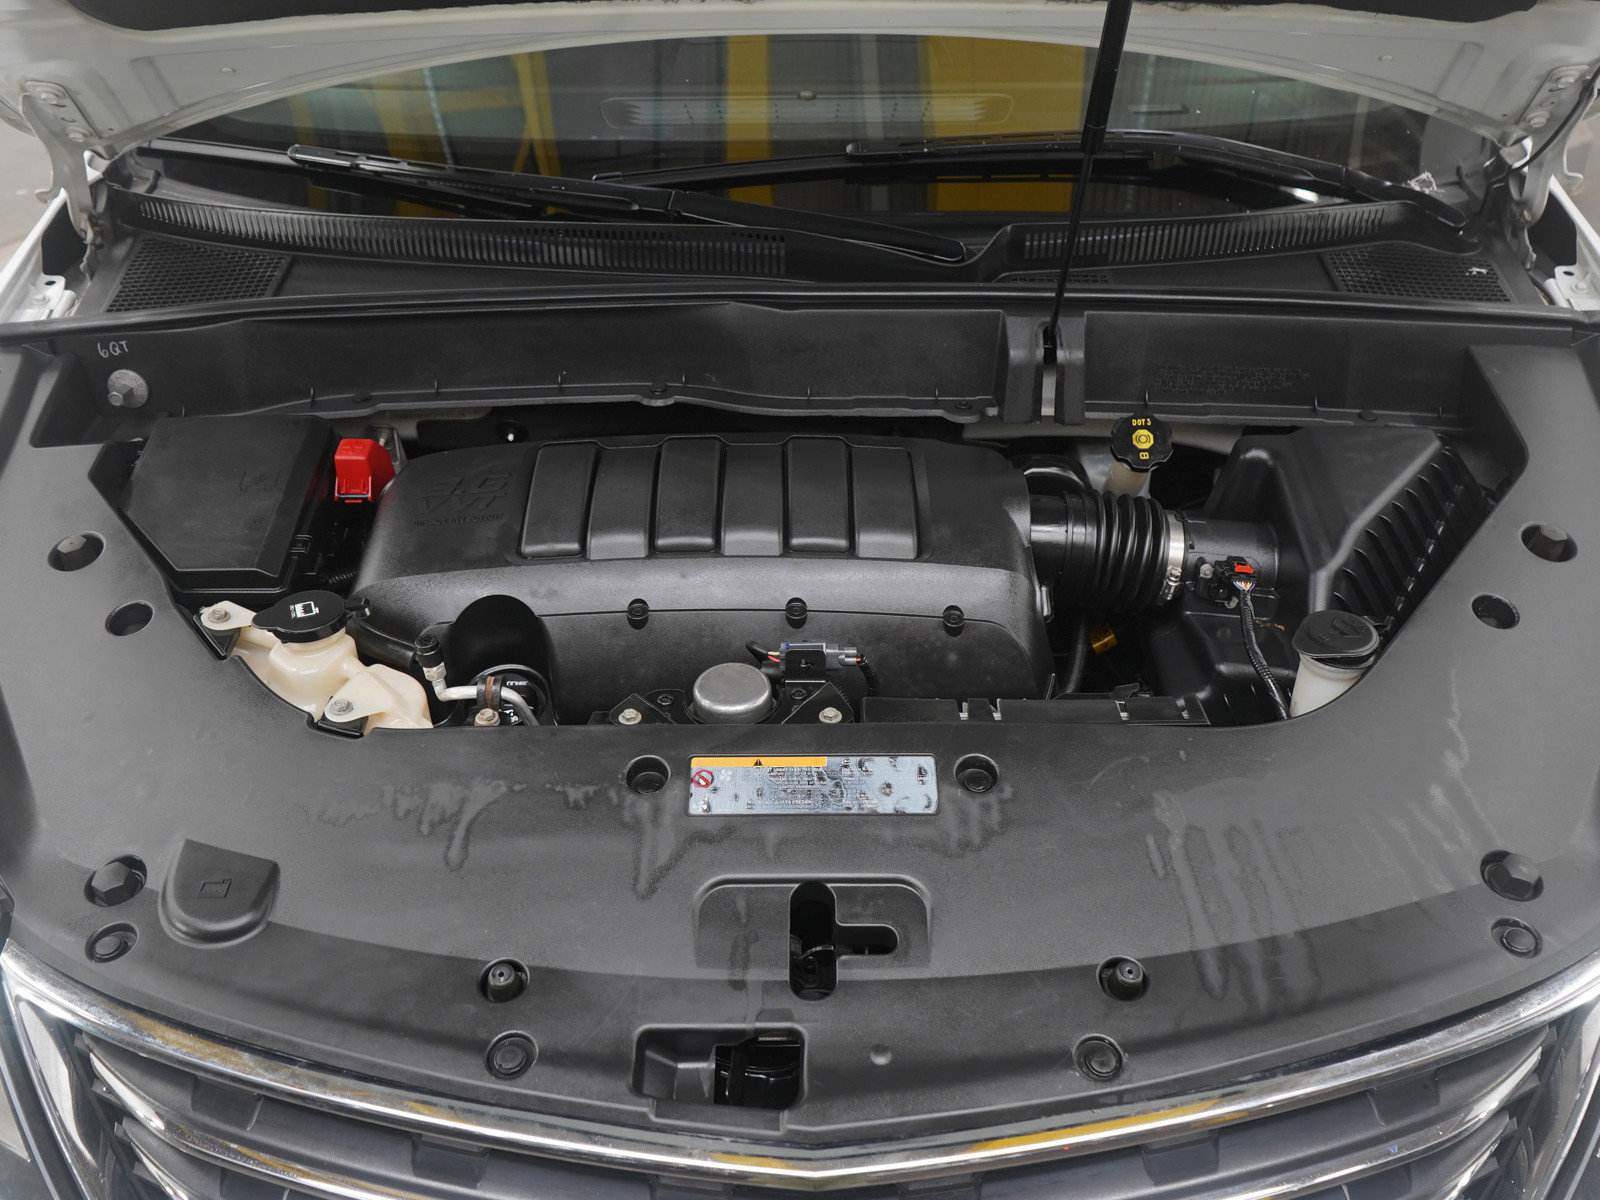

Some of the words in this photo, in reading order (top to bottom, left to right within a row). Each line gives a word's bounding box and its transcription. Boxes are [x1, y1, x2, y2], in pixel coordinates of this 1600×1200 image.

[97, 340, 128, 358] 6QT
[1132, 418, 1146, 426] DOT
[1146, 418, 1152, 426] 3
